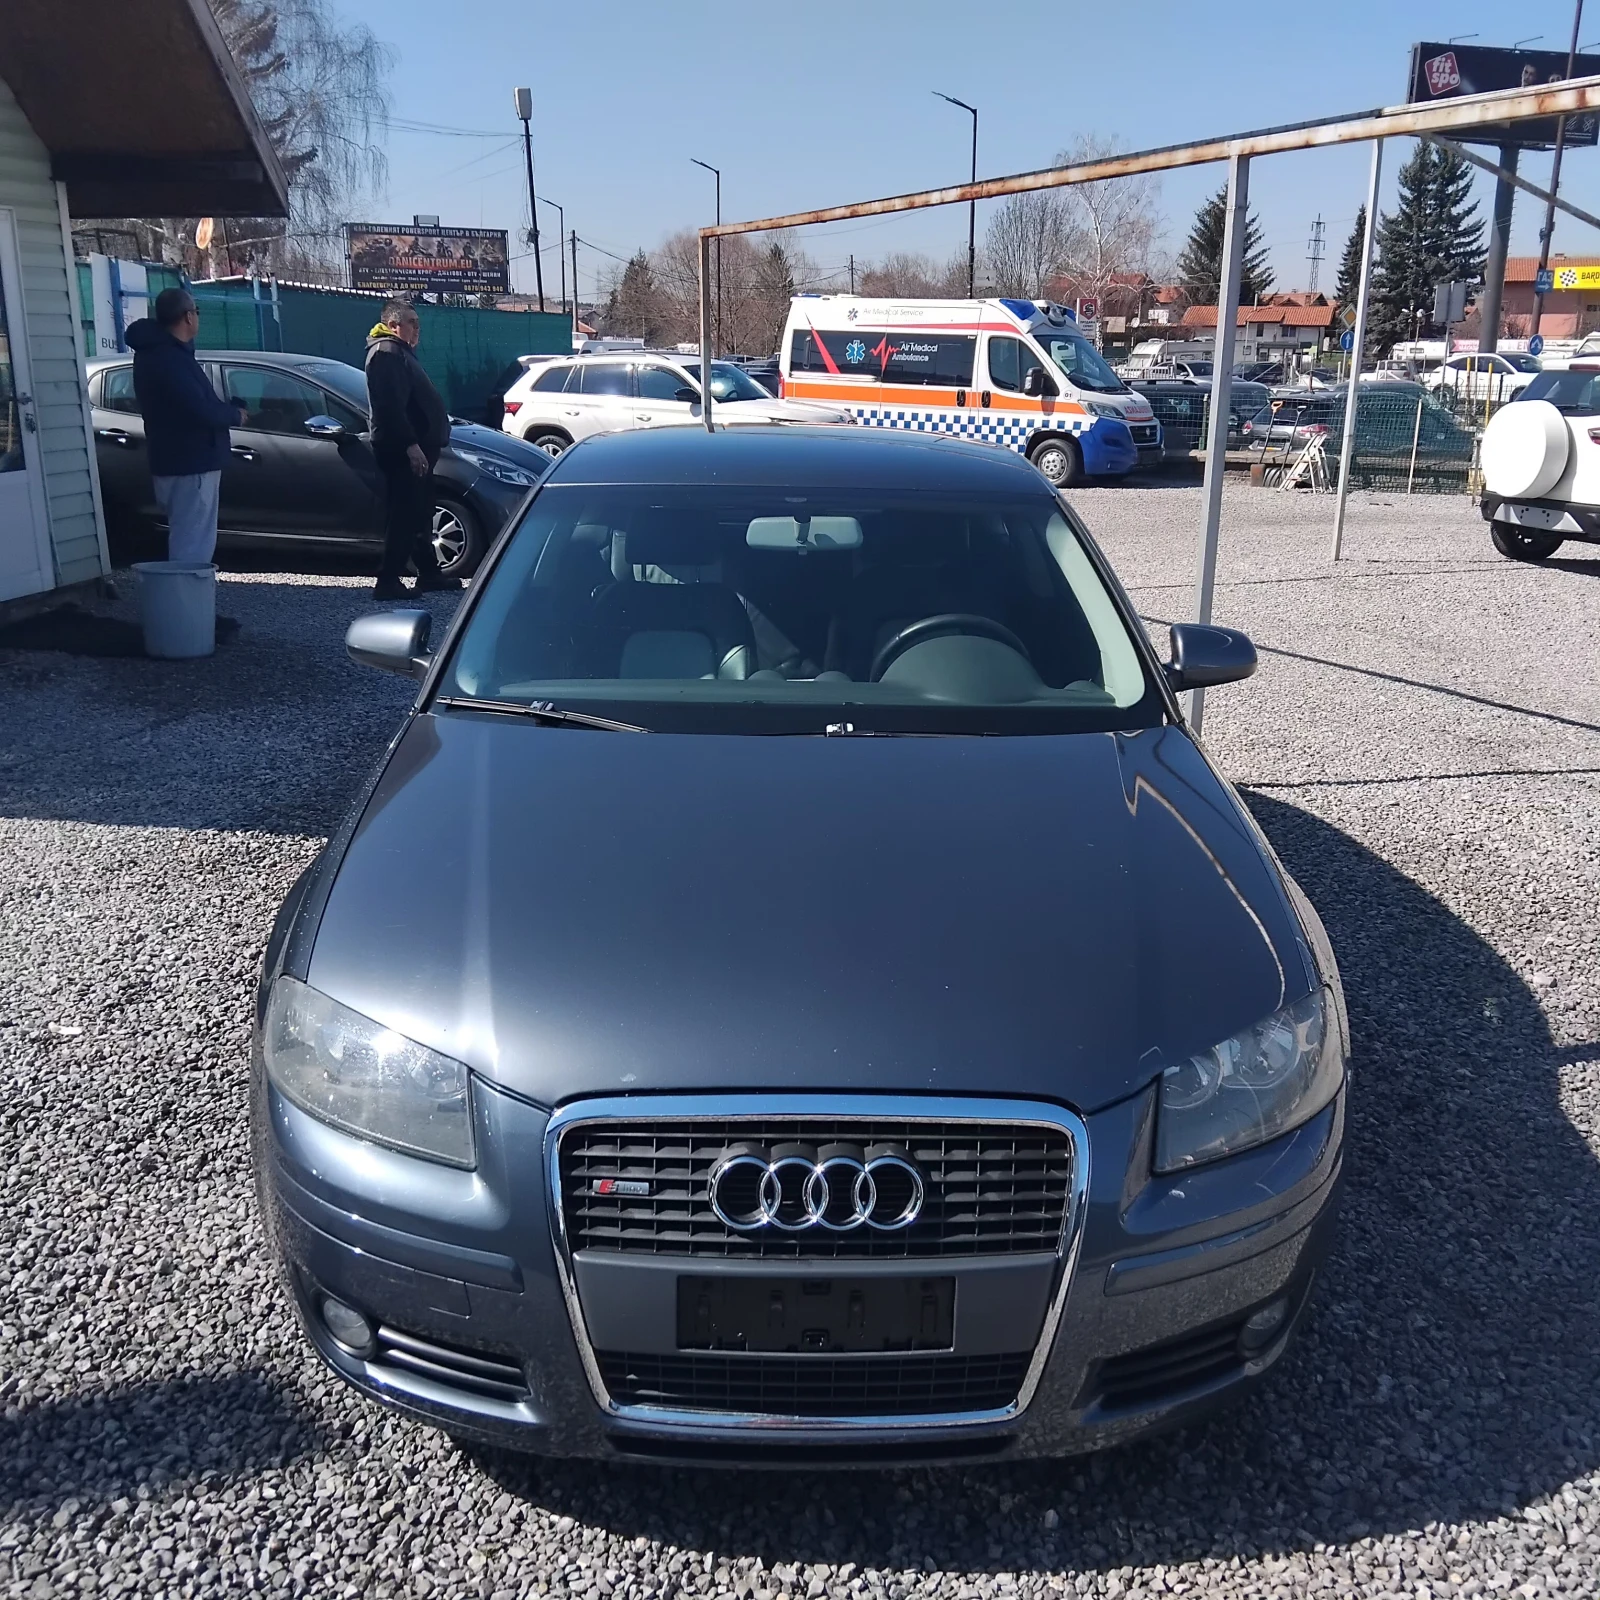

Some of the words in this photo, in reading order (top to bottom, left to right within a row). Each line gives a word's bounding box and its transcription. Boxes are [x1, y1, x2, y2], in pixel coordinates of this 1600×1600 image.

[1432, 57, 1452, 73] fit
[1431, 72, 1459, 88] spo
[402, 227, 440, 235] POWERSPORT
[441, 229, 464, 237] ЦЕНТЪР
[388, 256, 472, 269] DANICENTRUM.EU
[1537, 271, 1554, 282] ГАЗ
[900, 342, 910, 351] Air
[911, 343, 938, 352] Medical
[892, 353, 929, 362] Ambulance
